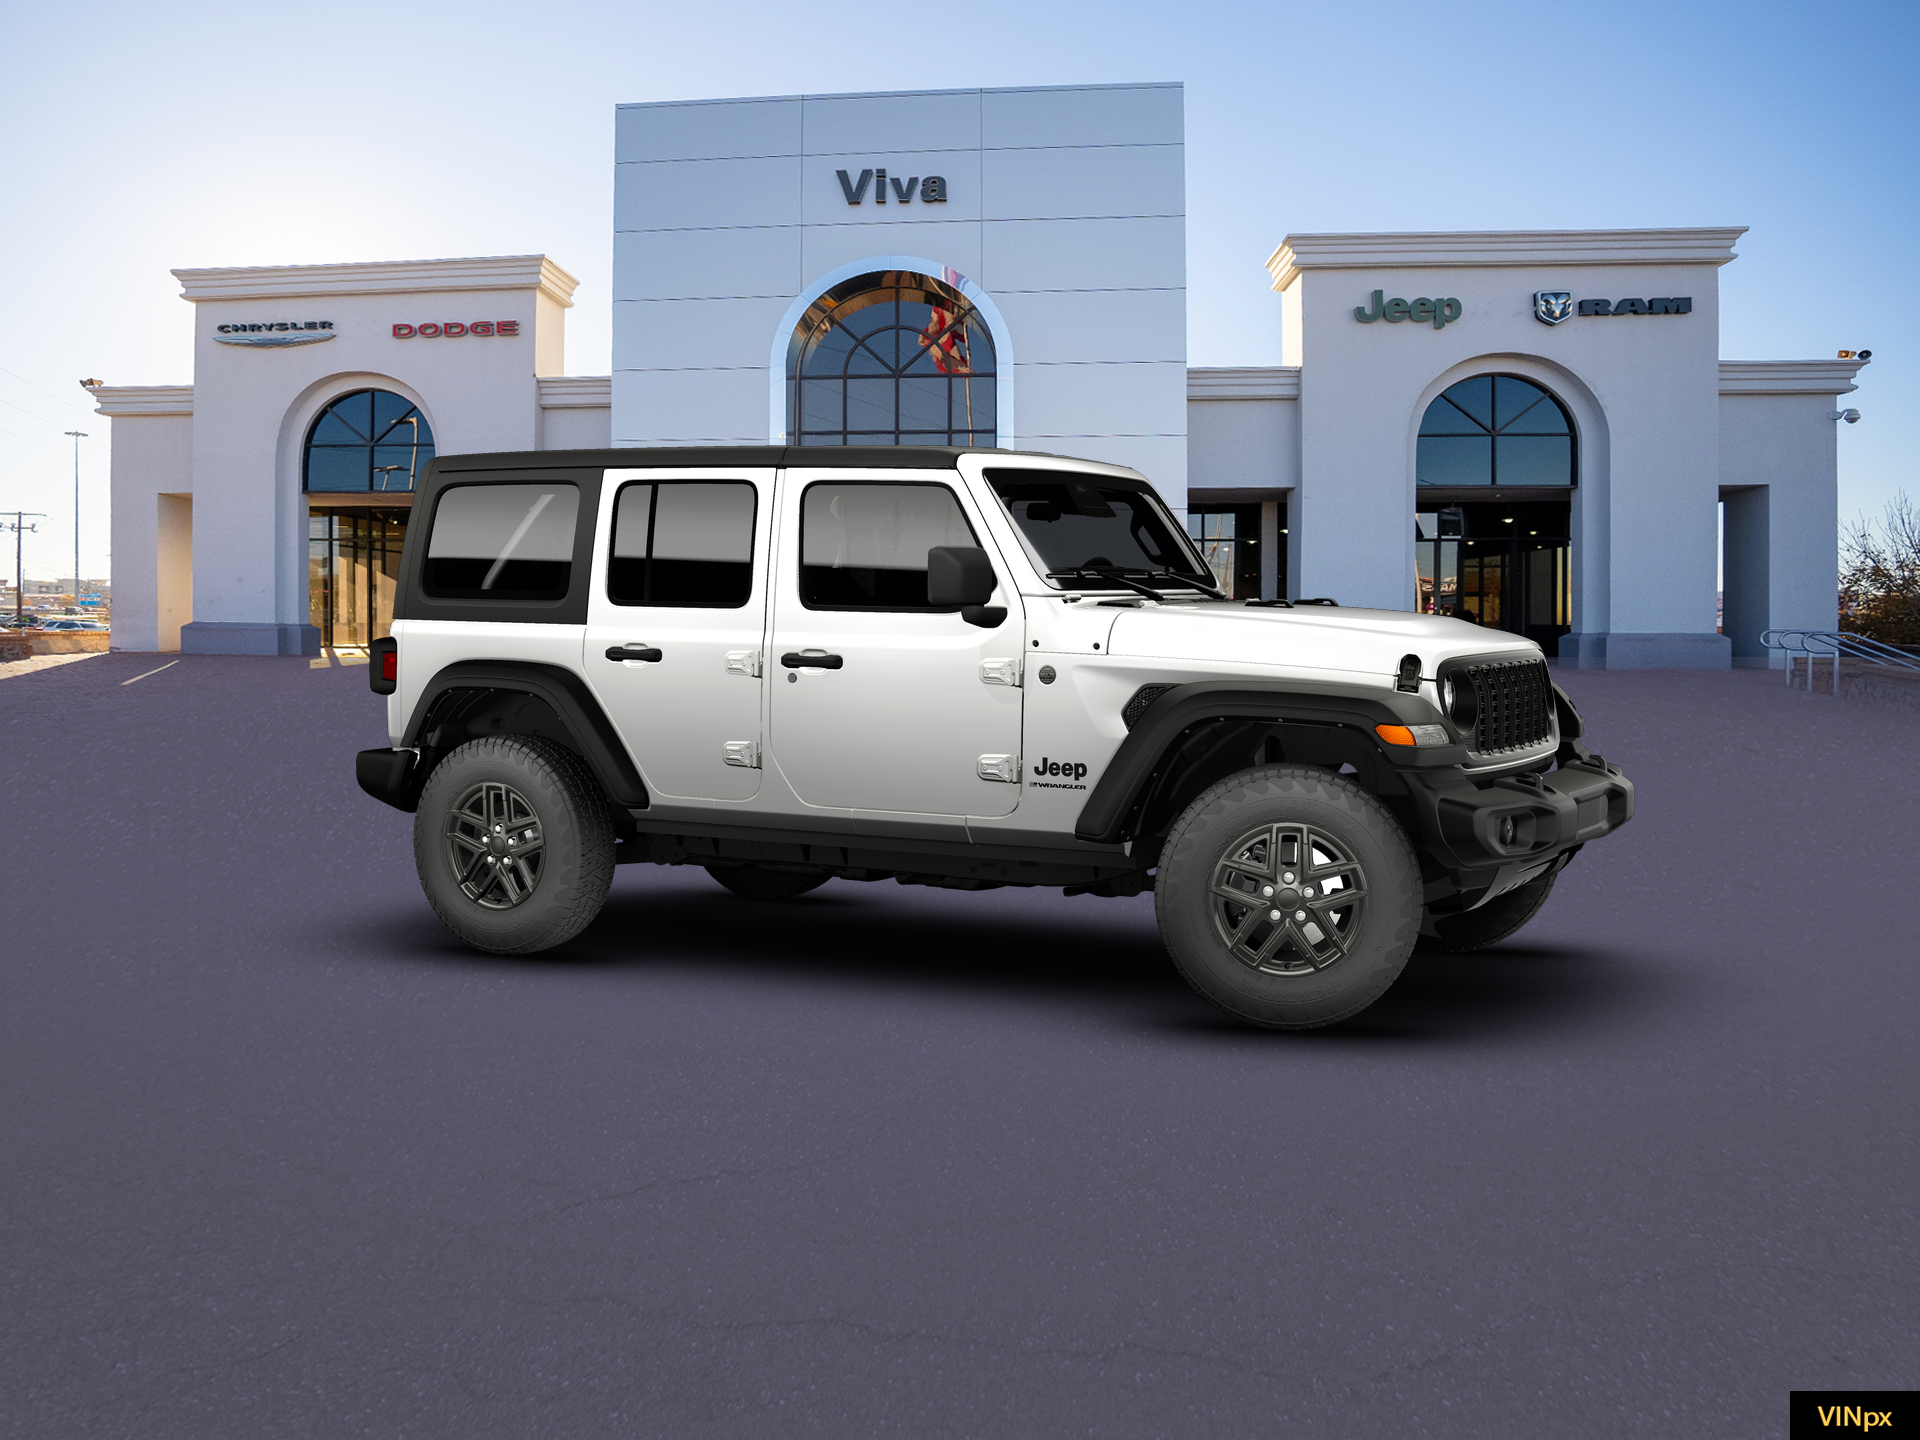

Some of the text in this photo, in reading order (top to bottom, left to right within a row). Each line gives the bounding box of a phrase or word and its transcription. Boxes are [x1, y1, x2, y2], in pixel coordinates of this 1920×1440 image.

[835, 168, 947, 205] Viva
[1354, 289, 1462, 329] Jeep
[1578, 297, 1692, 316] RAM
[217, 321, 334, 333] CHRYSLER
[392, 320, 520, 339] DODGE
[1033, 757, 1087, 781] Jeep
[1037, 782, 1086, 790] WRANGLER
